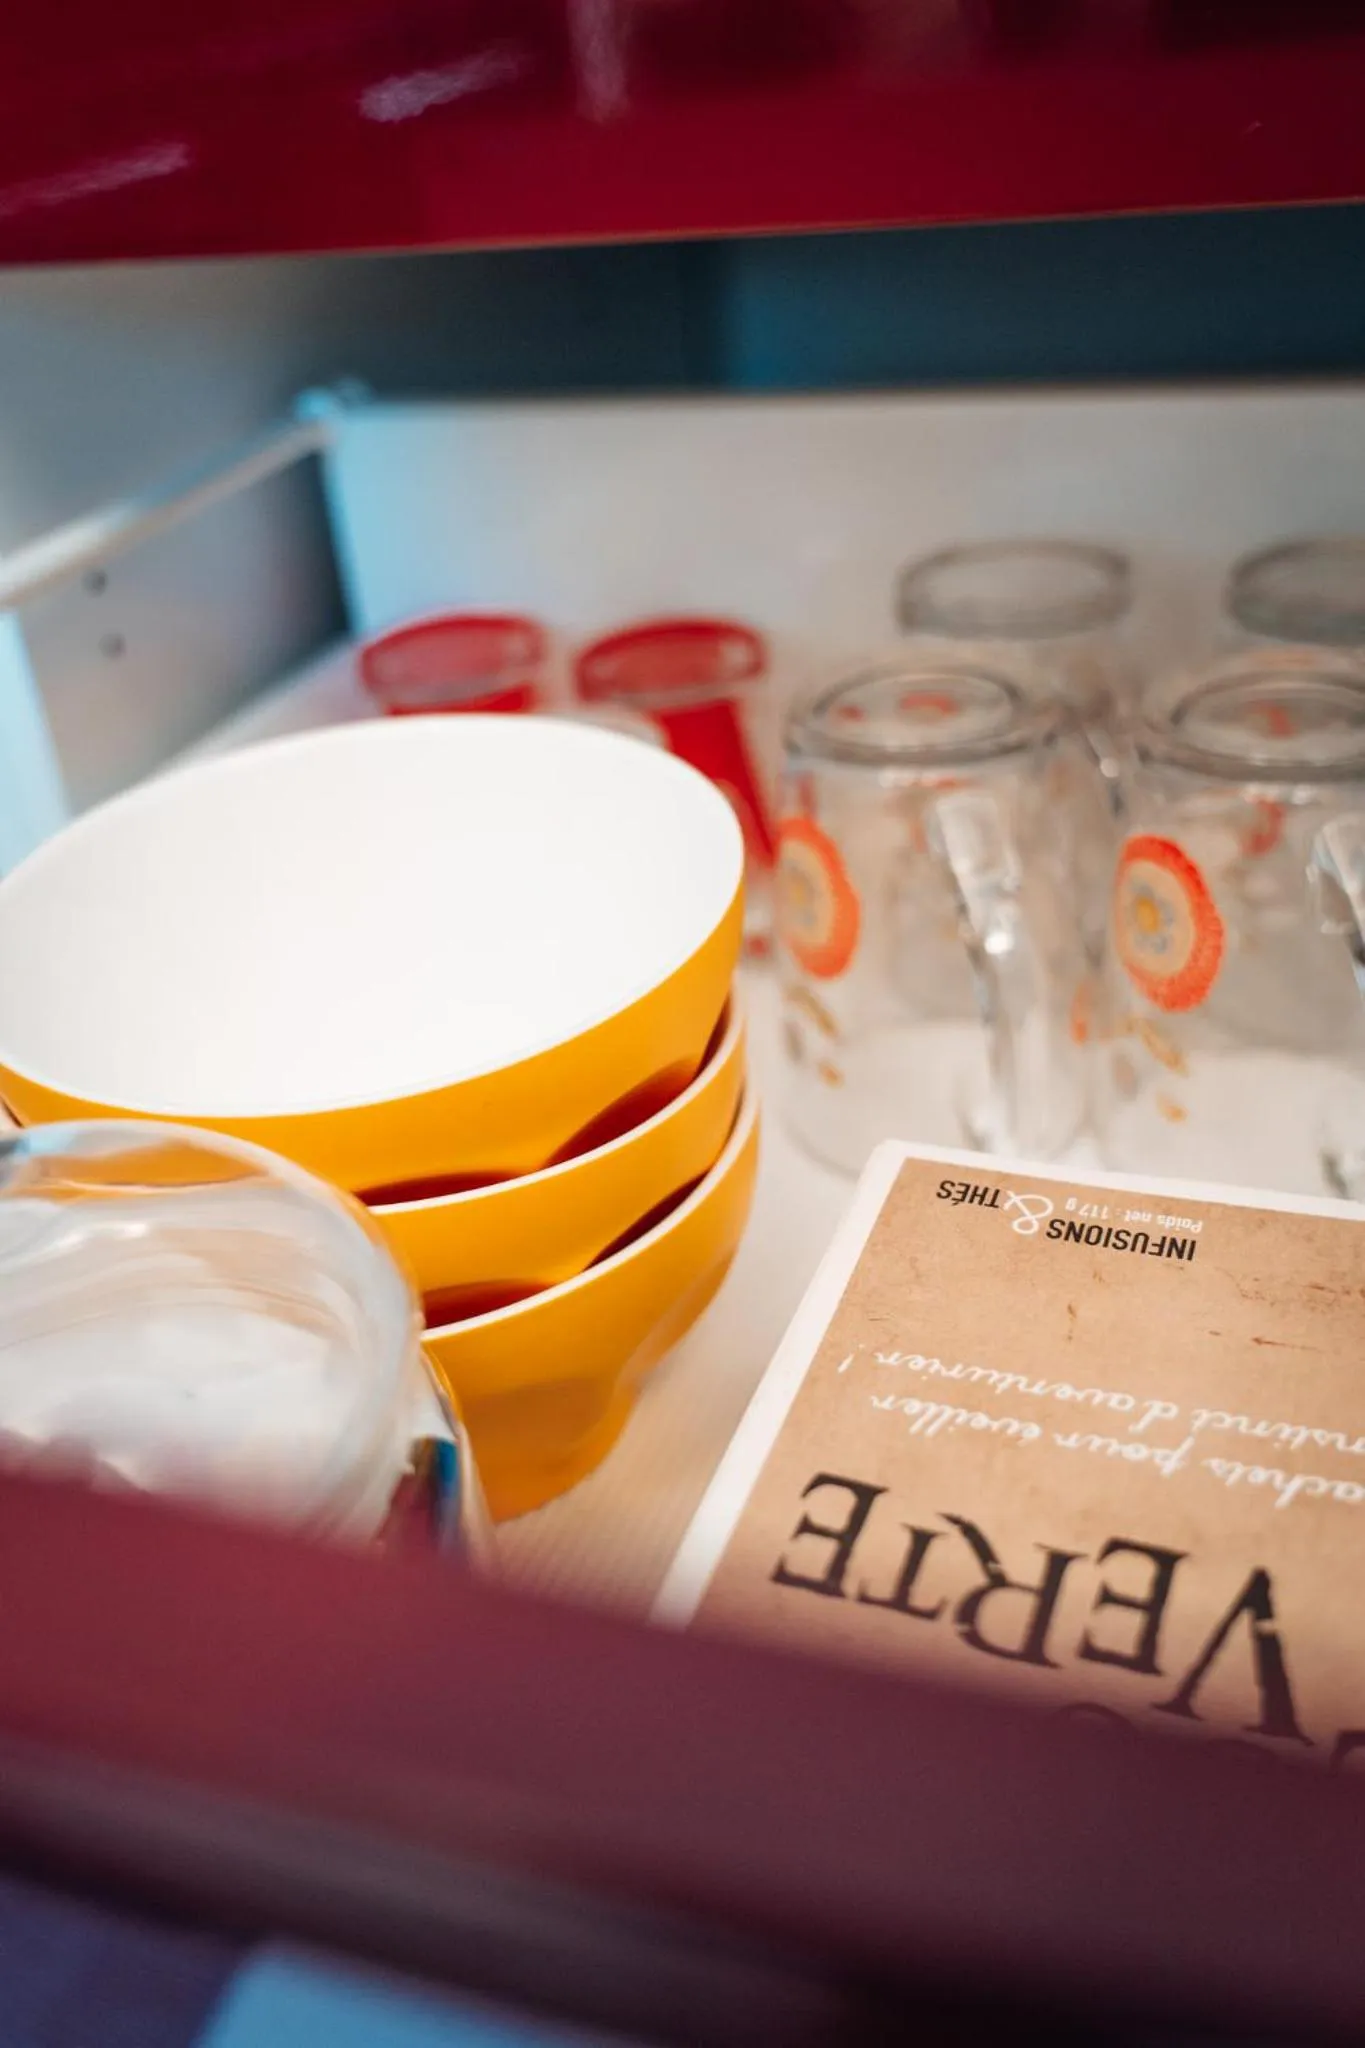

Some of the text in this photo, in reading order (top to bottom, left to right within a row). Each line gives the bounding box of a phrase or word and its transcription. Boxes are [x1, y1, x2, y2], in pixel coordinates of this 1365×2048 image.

[936, 1180, 1197, 1261] INFUSIONS & THÉS
[1079, 1203, 1109, 1220] 117
[1124, 1210, 1152, 1223] net
[1156, 1214, 1204, 1234] Poids
[871, 1395, 1042, 1446] éveiller
[1053, 1433, 1196, 1478] pour
[771, 1472, 1314, 1746] VERTE
